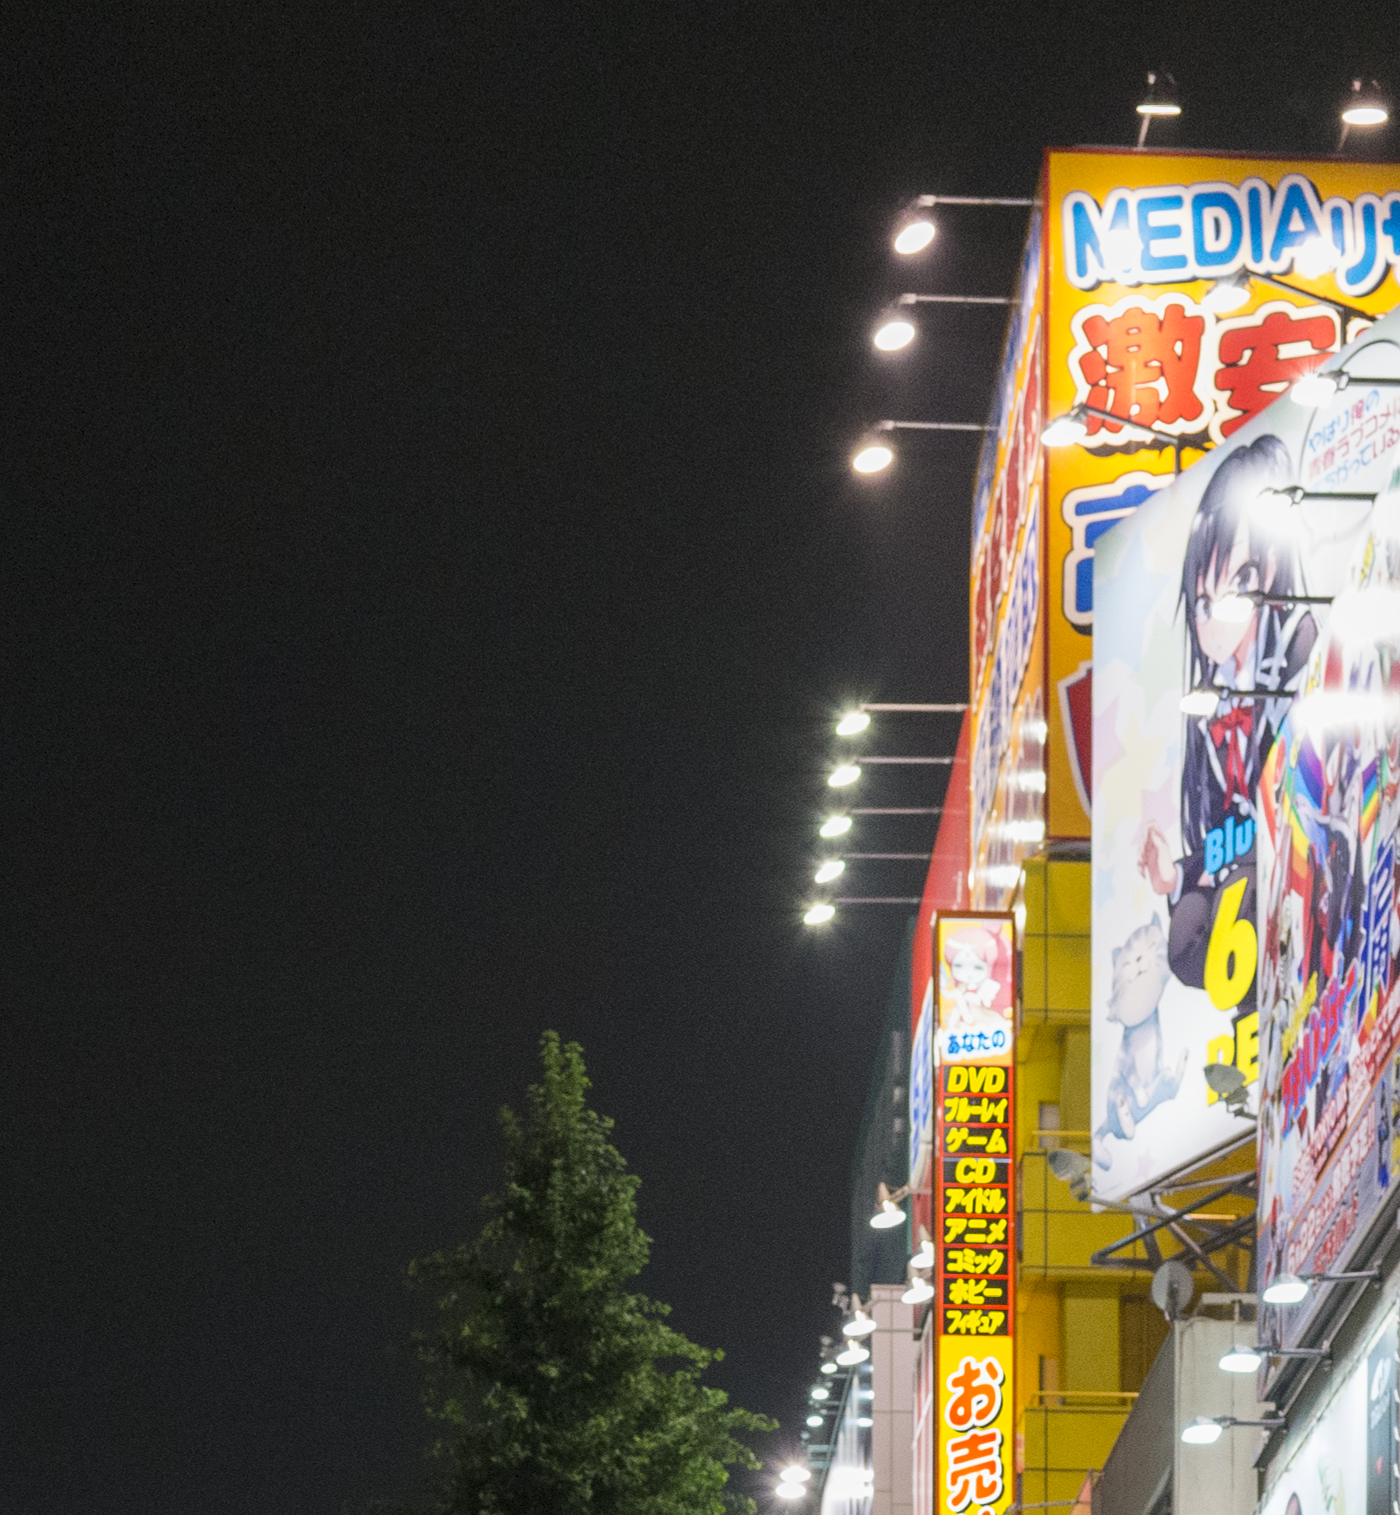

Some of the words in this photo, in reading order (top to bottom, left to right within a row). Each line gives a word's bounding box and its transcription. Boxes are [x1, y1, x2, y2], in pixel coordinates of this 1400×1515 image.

[947, 1029, 1006, 1055] あなたの
[948, 1066, 1006, 1094] DVD
[946, 1126, 1007, 1154] ゲーム
[955, 1157, 997, 1184] CD
[945, 1187, 1006, 1214] アイドル
[944, 1217, 1007, 1244] アニメ
[947, 1247, 1005, 1275] コミック
